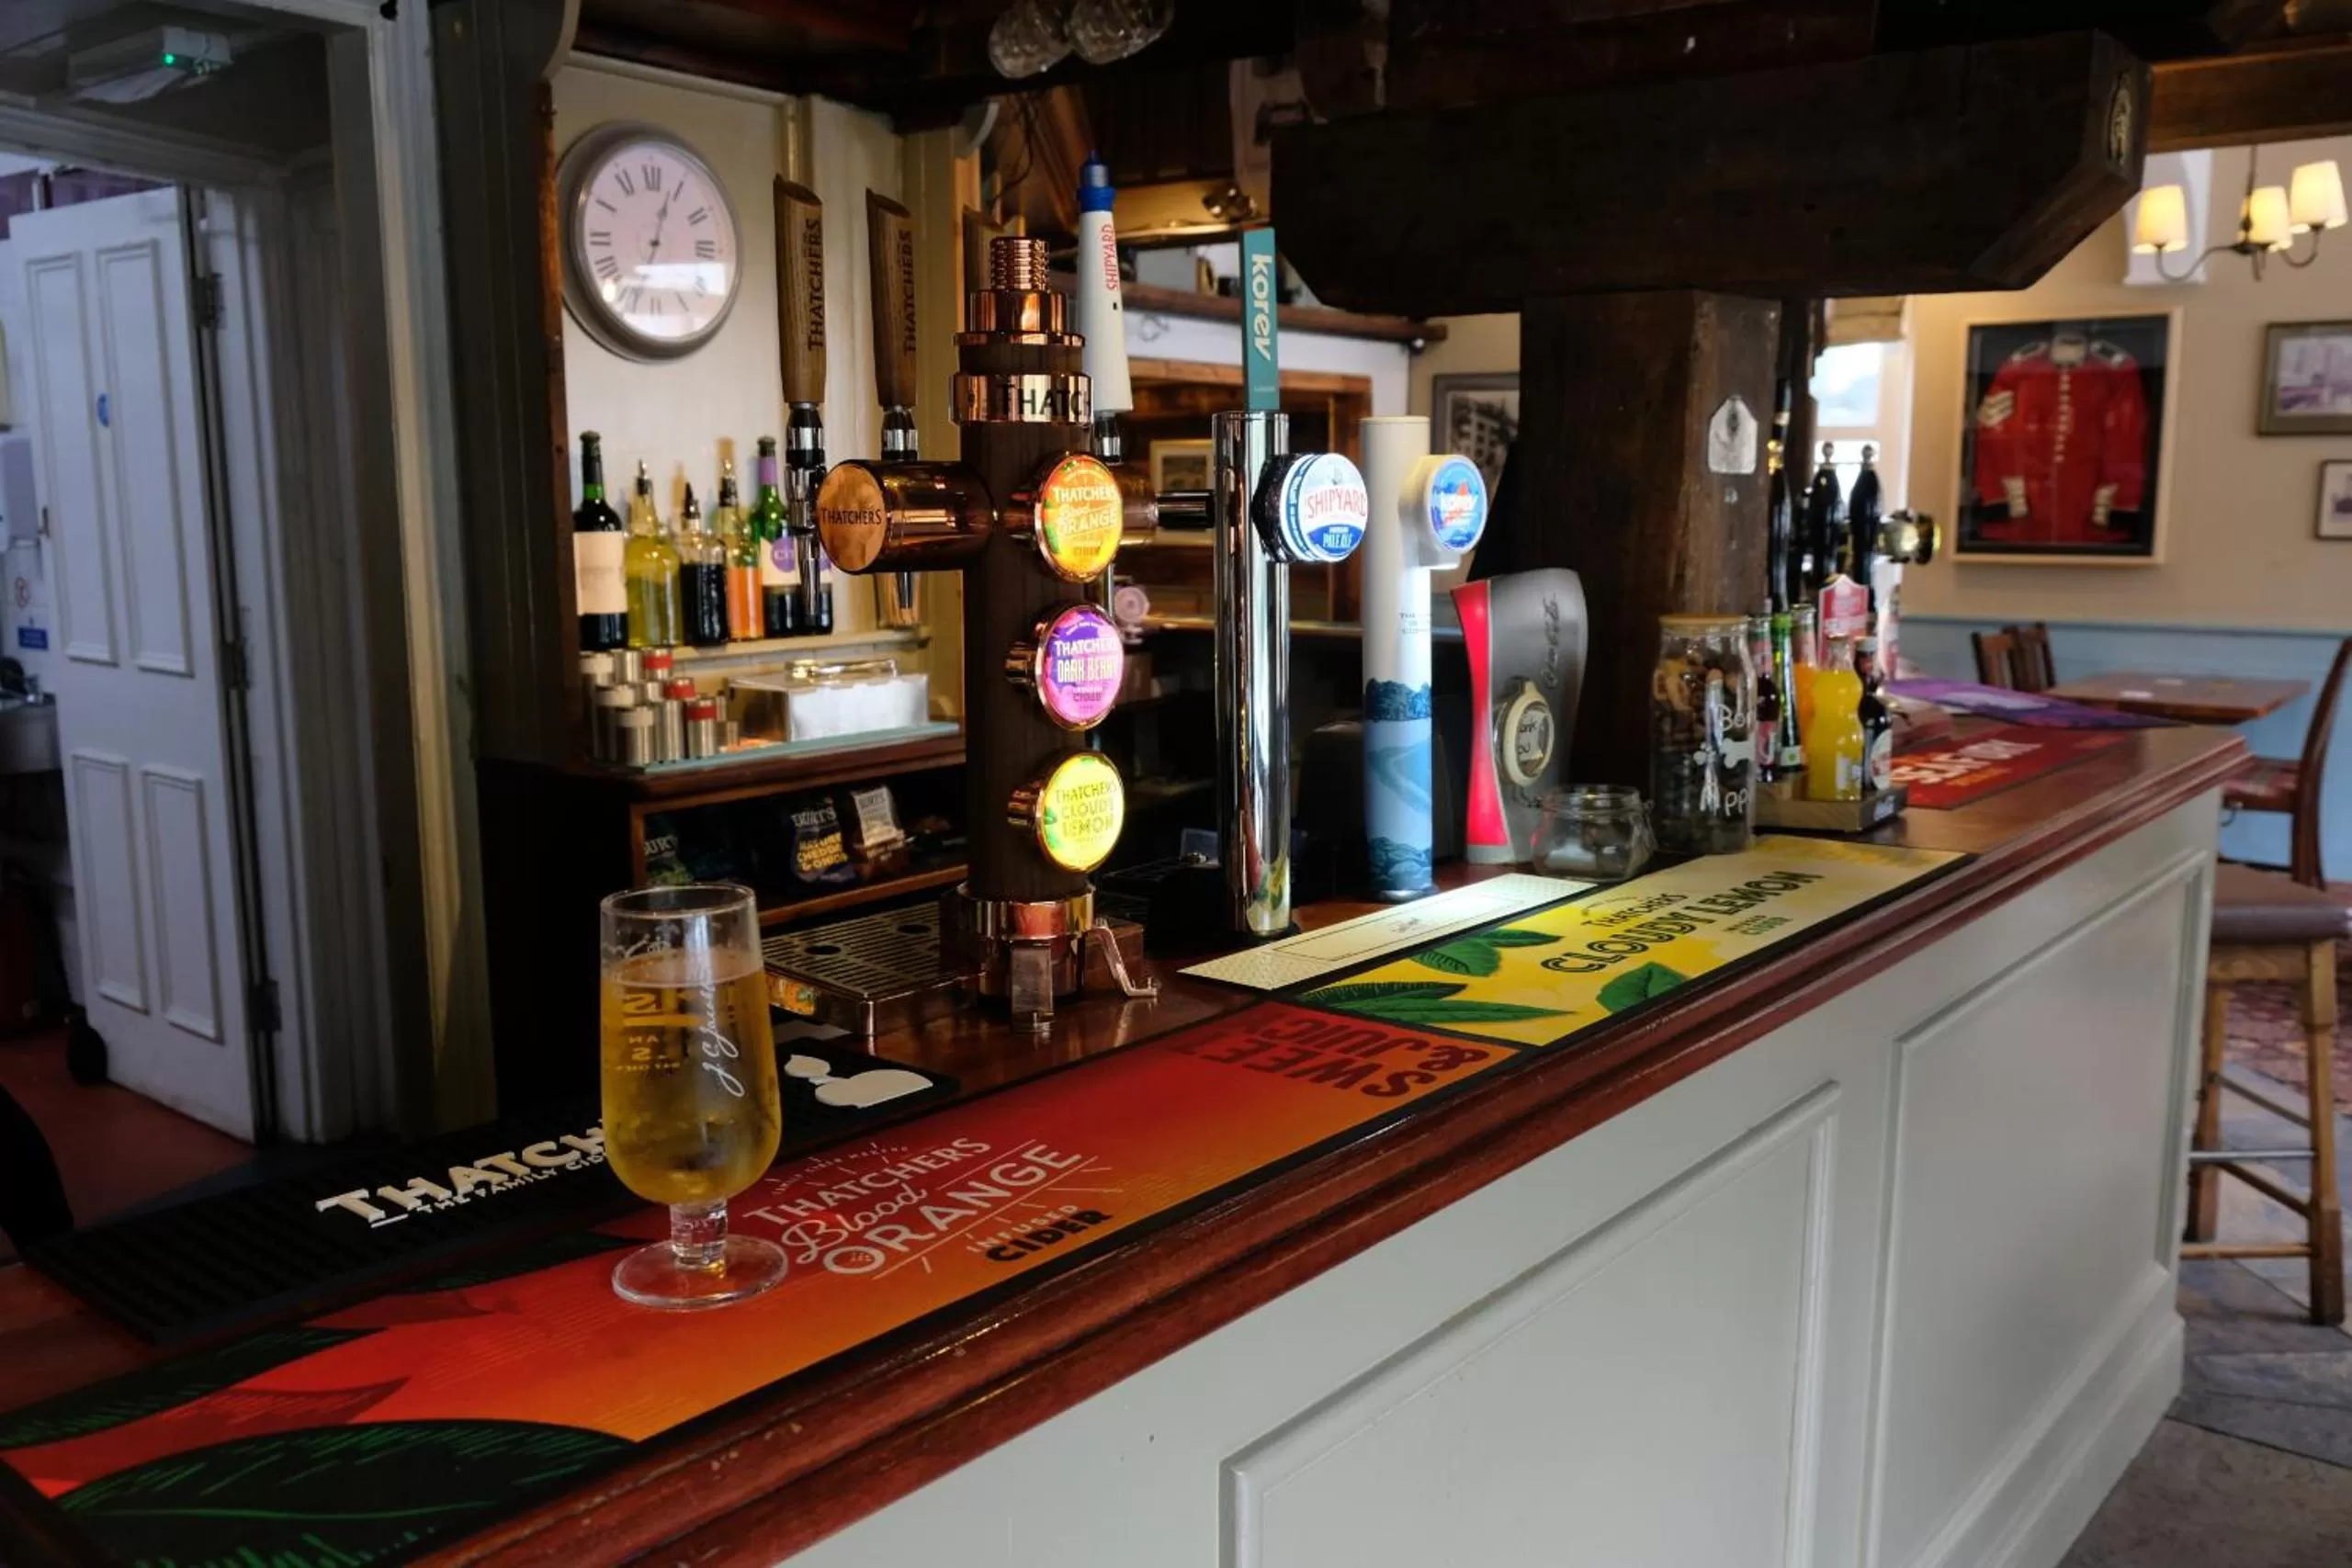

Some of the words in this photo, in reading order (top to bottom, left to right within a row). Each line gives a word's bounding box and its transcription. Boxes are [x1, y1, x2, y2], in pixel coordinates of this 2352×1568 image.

[807, 217, 824, 353] THATCHERS
[1101, 223, 1121, 291] SHIPYARD
[902, 228, 916, 356] THATCHERS
[821, 507, 884, 526] THATCHERS
[1057, 508, 1119, 534] ORANGE
[1306, 487, 1366, 519] SHIPYARD
[1056, 780, 1118, 805] THATCHERS
[1062, 814, 1115, 838] LEMON
[1540, 905, 1717, 974] CLOUDY
[1699, 870, 1826, 916] LEMON
[1580, 892, 1689, 929] THATCHERS
[1167, 1032, 1438, 1098] SWEET
[315, 1126, 605, 1224] THATCH
[474, 1168, 558, 1198] FAMILY
[742, 1137, 992, 1226] THATCHERS
[781, 1181, 928, 1265] Blood
[824, 1144, 1082, 1275] ORANGE
[966, 1203, 1082, 1253] INFUSED
[985, 1208, 1114, 1263] CIDER
